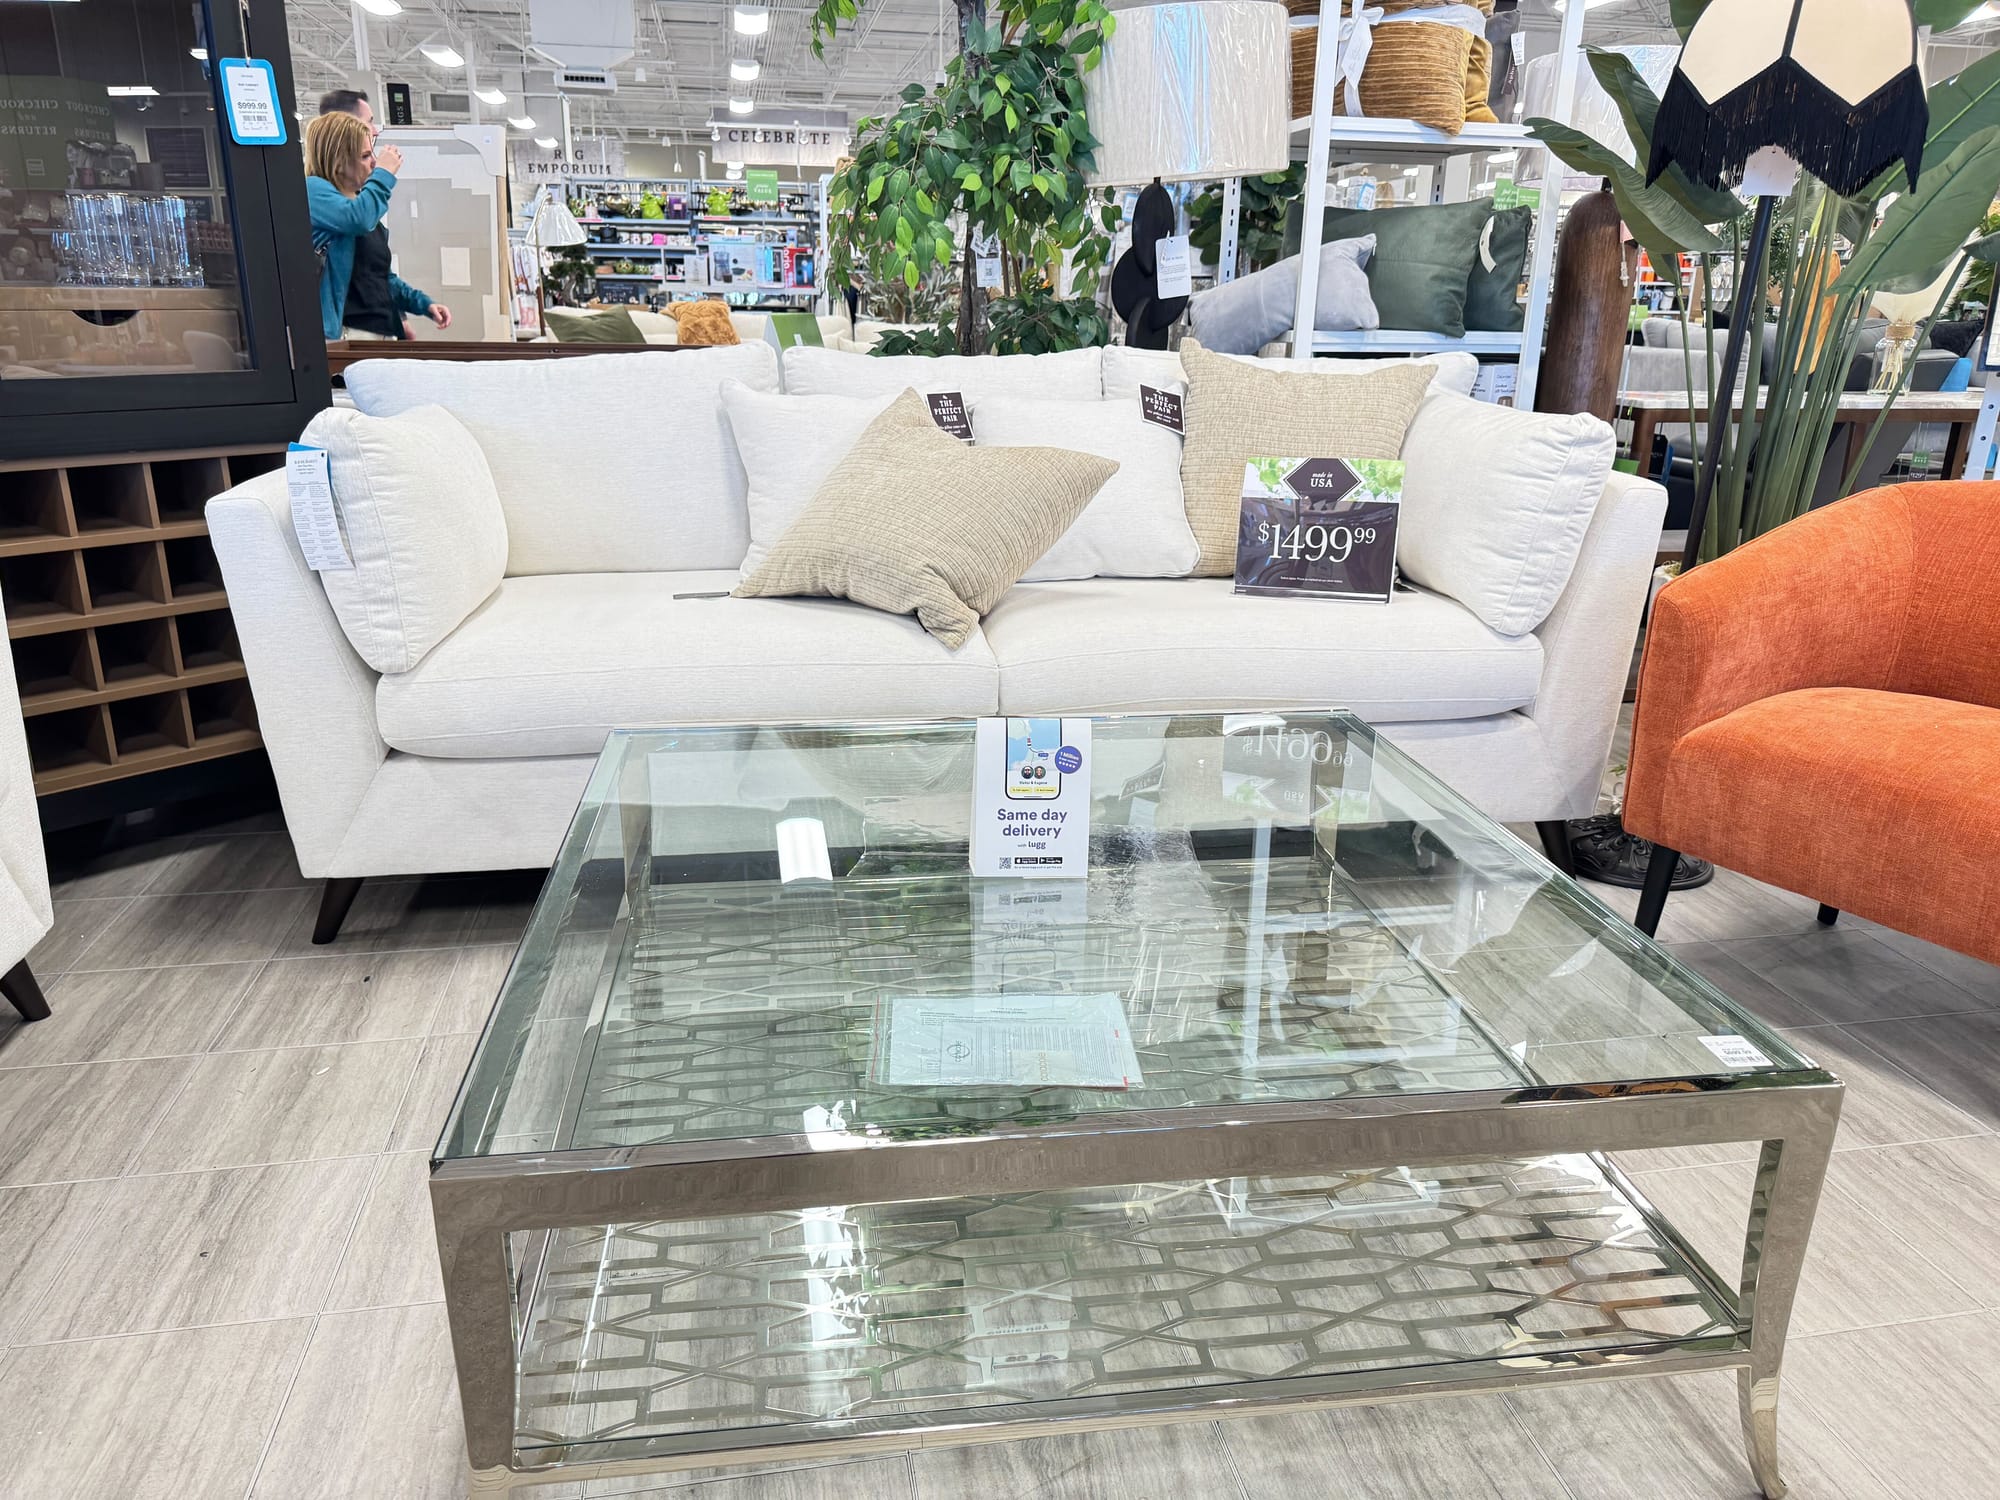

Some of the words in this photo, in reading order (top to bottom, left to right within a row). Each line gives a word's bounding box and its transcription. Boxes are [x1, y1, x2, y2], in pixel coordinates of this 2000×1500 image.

[237, 101, 268, 110] $999.99
[728, 129, 831, 145] CELEBRTE
[554, 149, 585, 160] RG
[527, 162, 612, 175] EMPORIUM
[1152, 393, 1169, 403] THE
[938, 399, 954, 408] THE
[1145, 396, 1178, 411] PERFECT
[933, 406, 963, 416] PERFECT
[1153, 404, 1171, 415] PAIR
[942, 414, 959, 423] PAIR
[1310, 478, 1334, 488] USA
[997, 808, 1038, 821] Same
[1041, 808, 1068, 824] day
[1002, 823, 1062, 840] delivery
[1028, 840, 1047, 850] lugg
